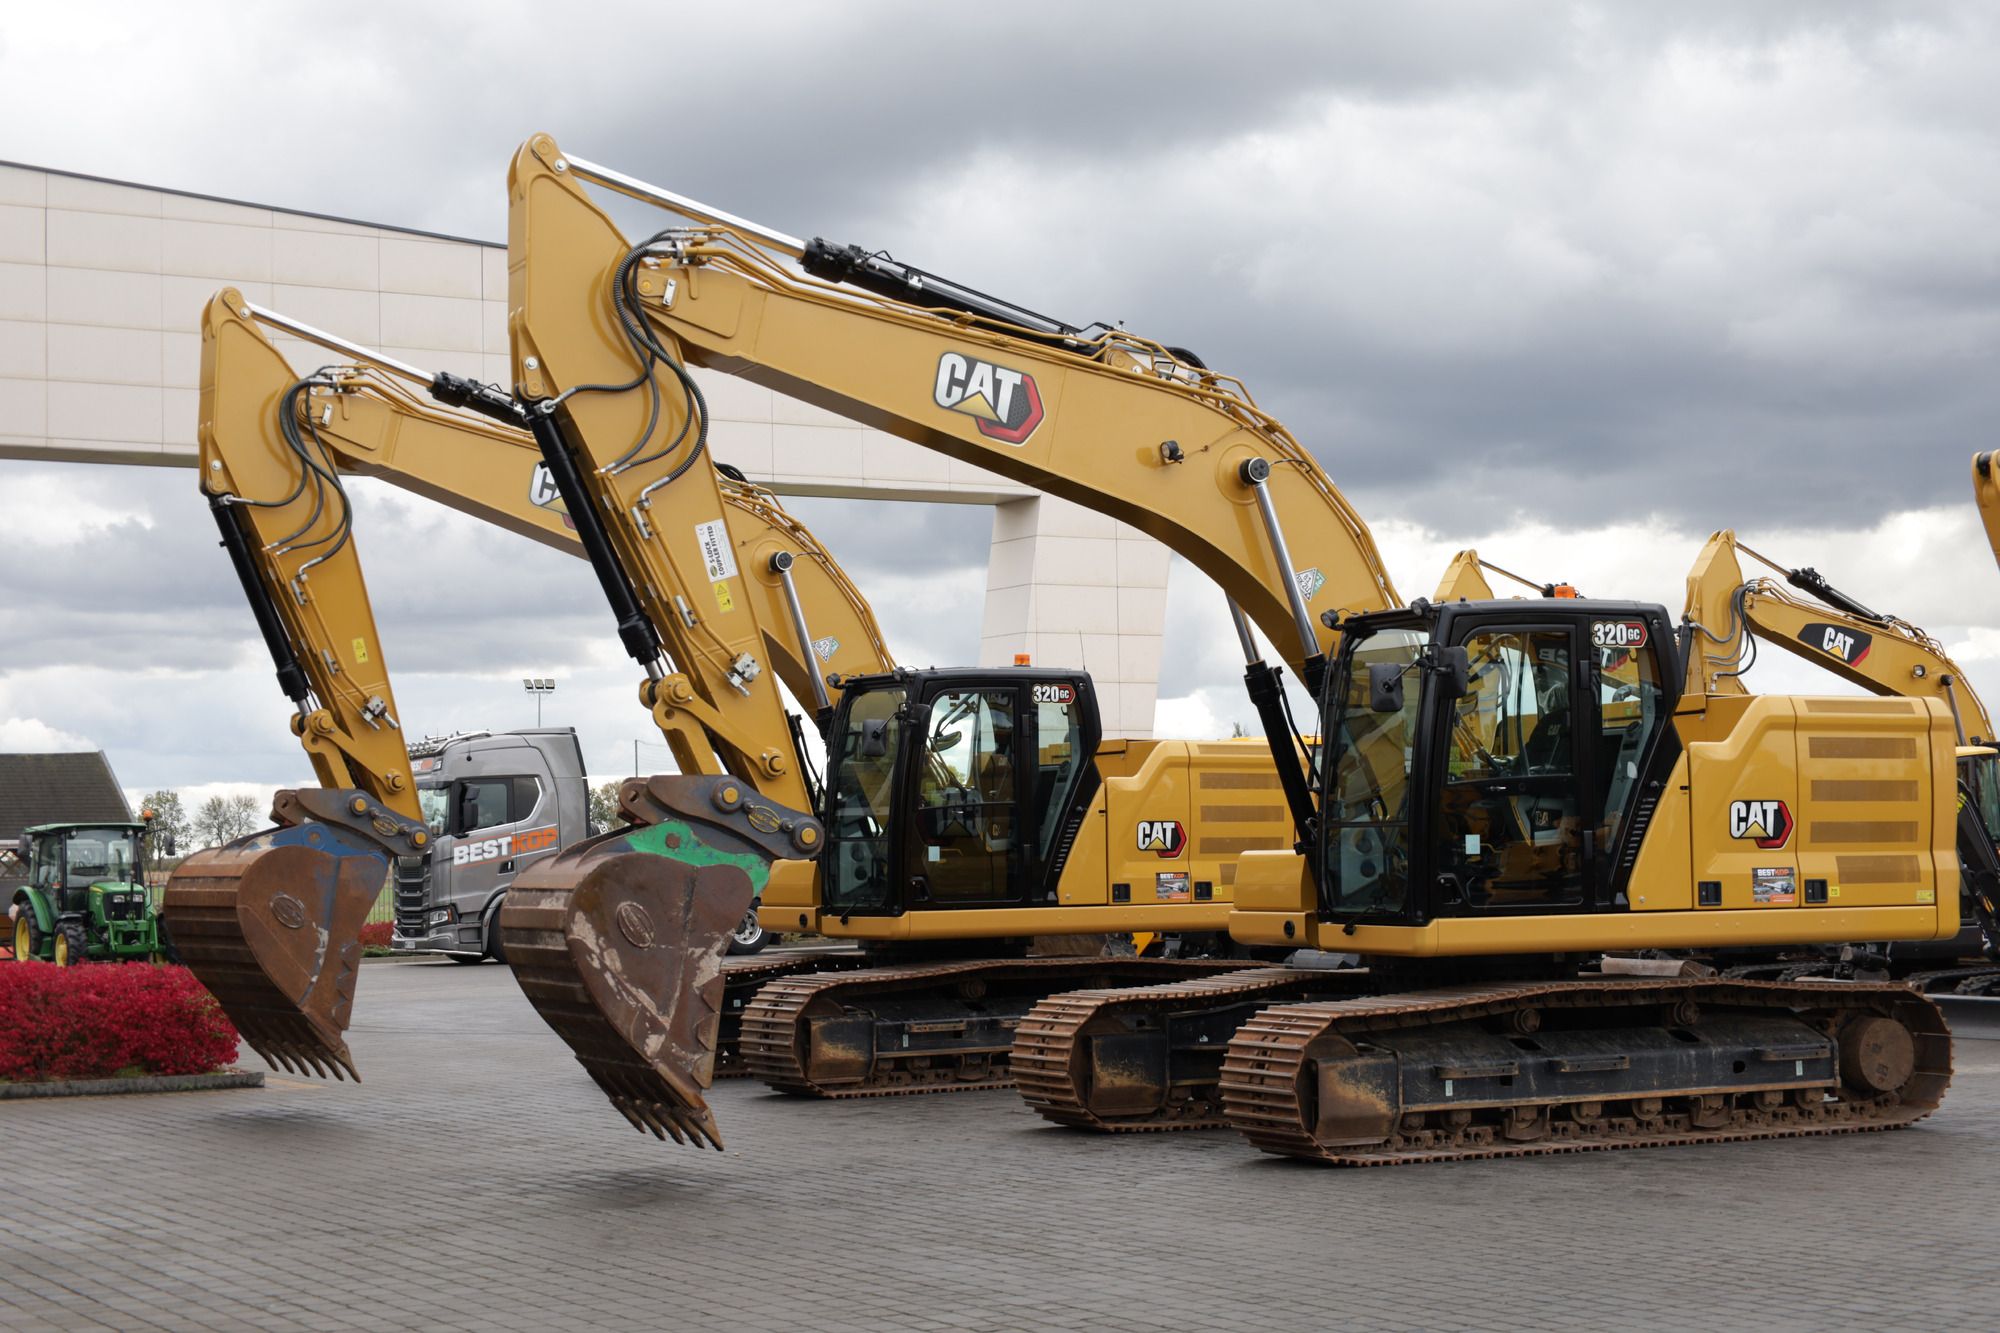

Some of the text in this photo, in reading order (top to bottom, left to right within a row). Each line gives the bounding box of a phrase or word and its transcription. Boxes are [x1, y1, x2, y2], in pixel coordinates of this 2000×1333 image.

[935, 353, 1022, 424] CAT
[706, 525, 717, 547] FITTED
[704, 541, 715, 564] S-LOCK
[712, 547, 726, 576] COUPLER
[1593, 623, 1627, 645] 320
[1822, 627, 1855, 661] CAT
[1033, 685, 1059, 702] 320
[1730, 801, 1778, 838] CAT
[1137, 821, 1175, 850] CAT
